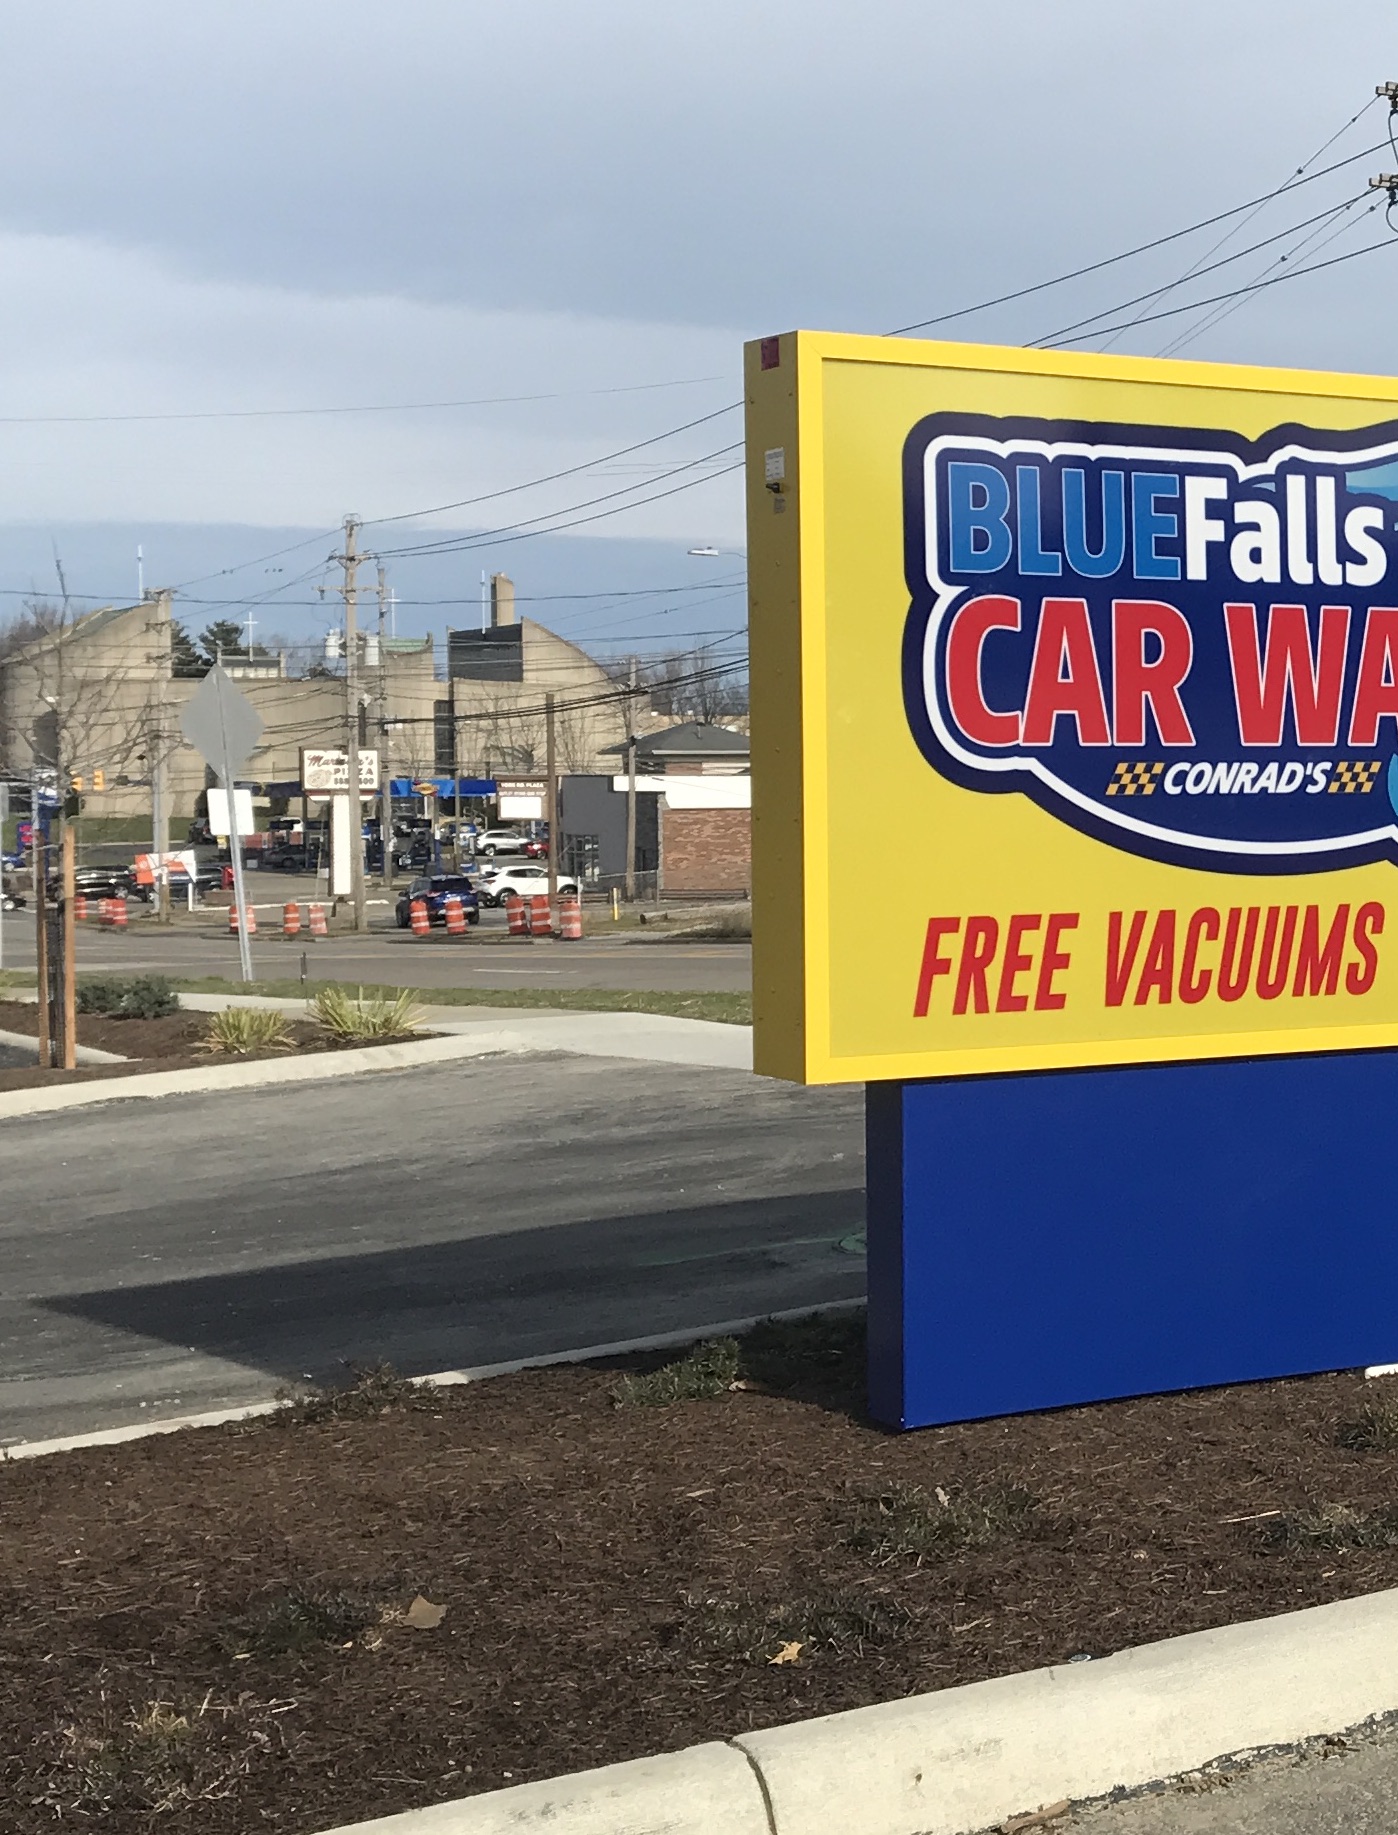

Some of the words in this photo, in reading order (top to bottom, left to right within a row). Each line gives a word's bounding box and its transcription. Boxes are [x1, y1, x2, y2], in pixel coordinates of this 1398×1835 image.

[945, 594, 1196, 747] CAR
[1163, 761, 1332, 795] CONRAD'S
[912, 912, 1081, 1018] FREE
[1104, 901, 1386, 1008] VACUUMS
